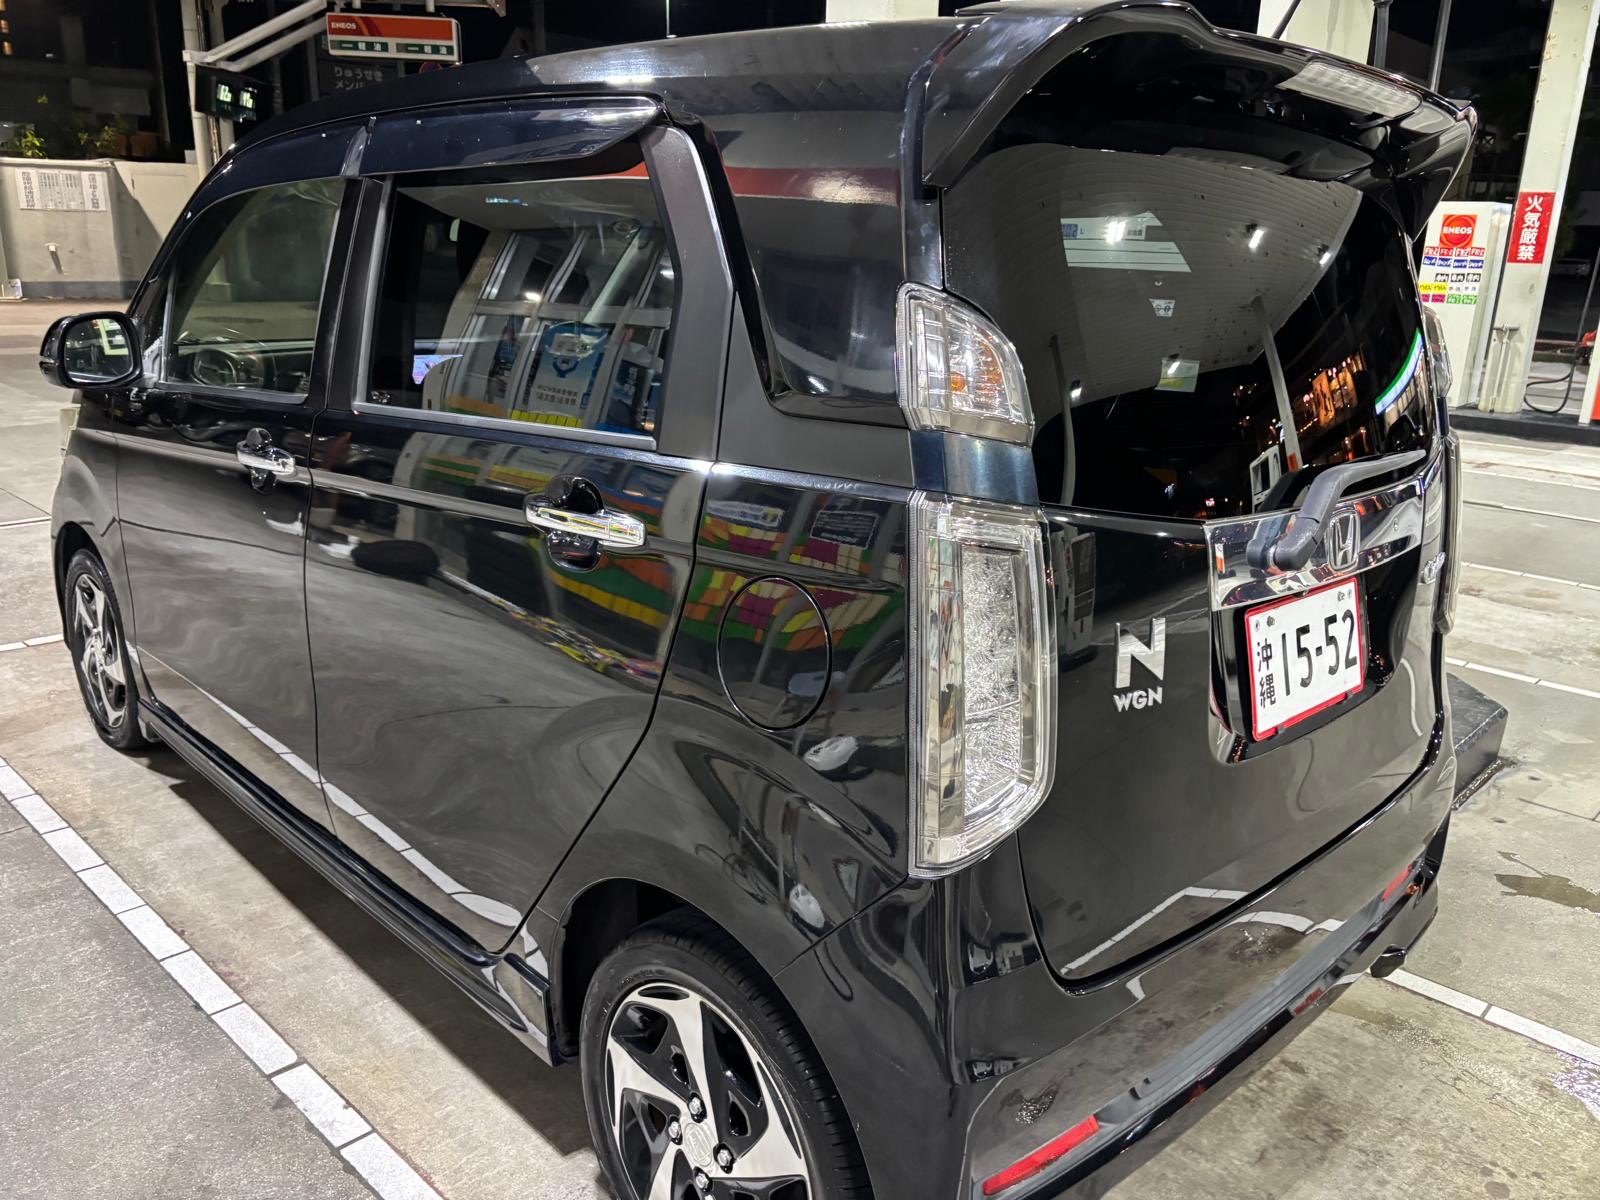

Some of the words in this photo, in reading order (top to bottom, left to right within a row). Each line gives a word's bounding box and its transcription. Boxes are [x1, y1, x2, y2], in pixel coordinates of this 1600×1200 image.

[330, 21, 357, 30] ENEOS
[1442, 226, 1473, 235] ENEOS
[1517, 194, 1544, 261] 火気厳禁
[1114, 616, 1167, 689] N
[1256, 637, 1277, 709] 沖縄
[1281, 608, 1358, 697] 15-52
[1112, 685, 1164, 713] WGN
